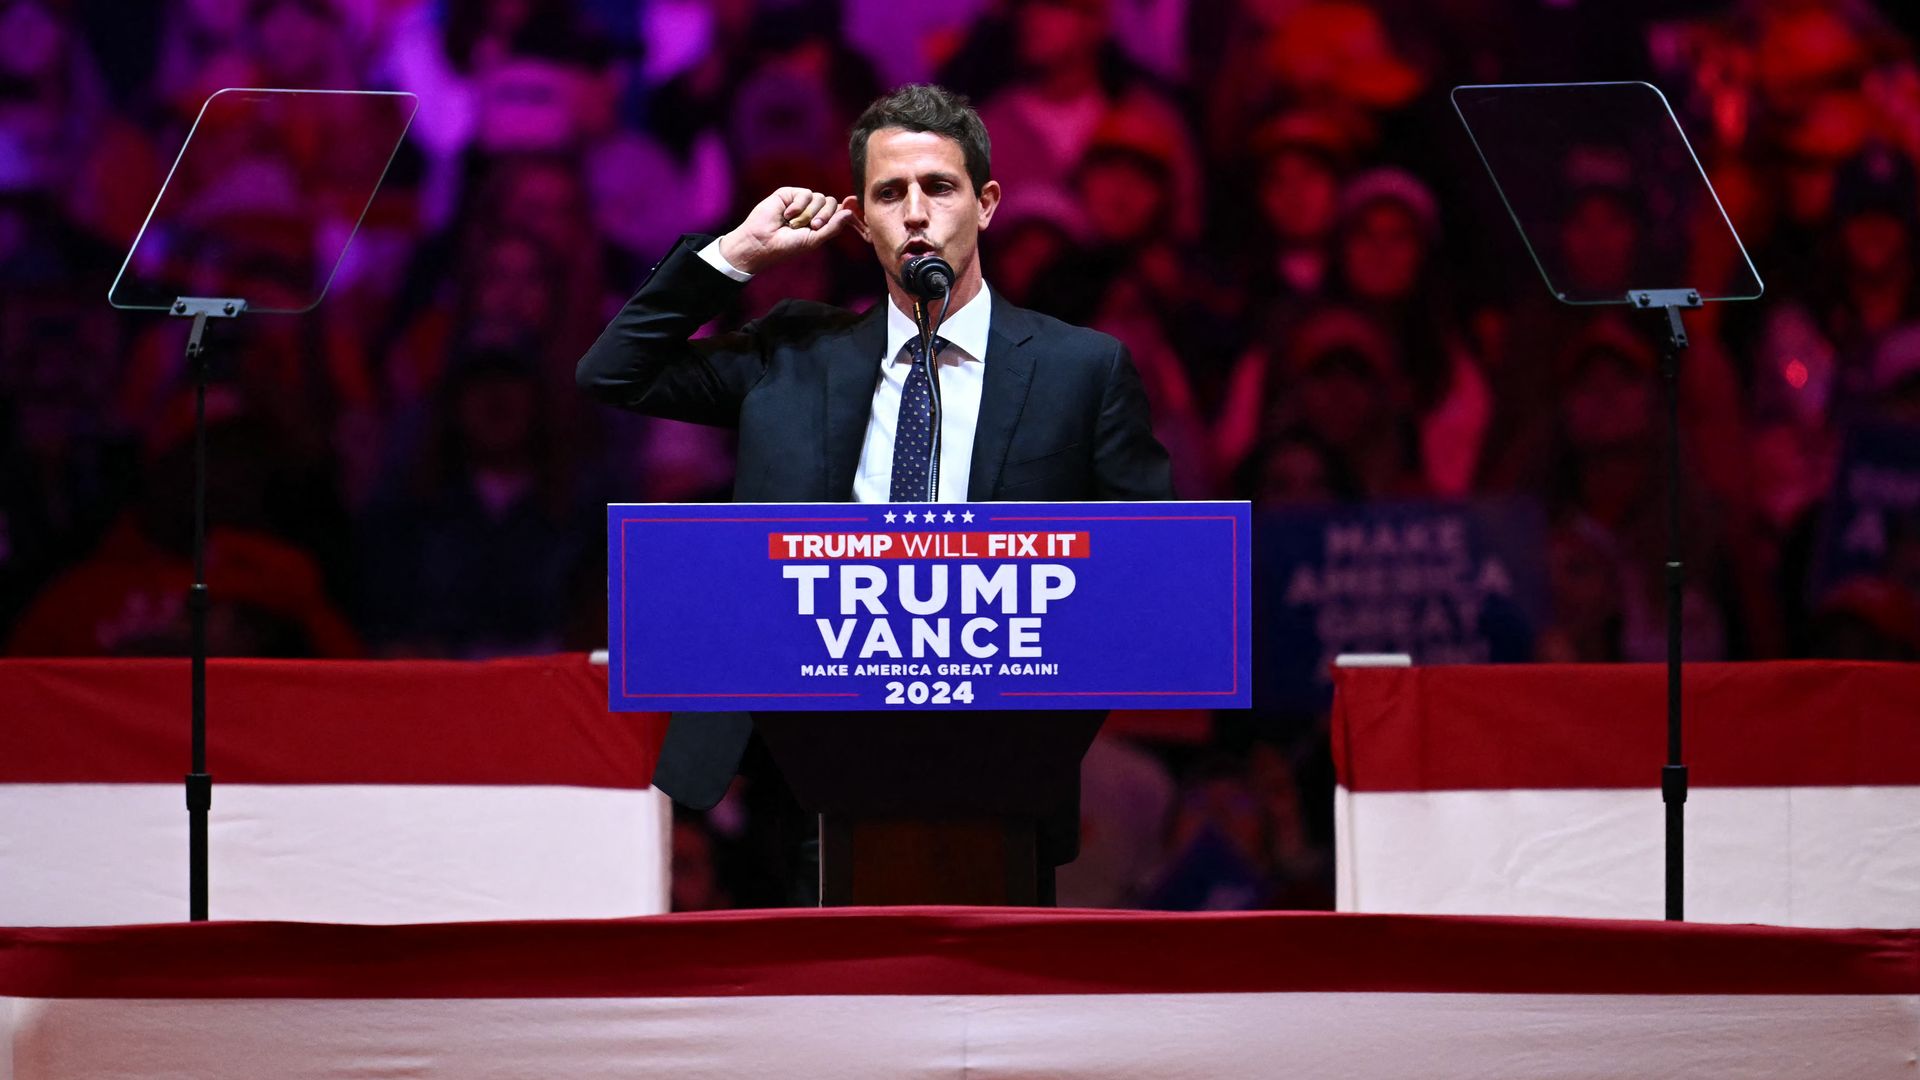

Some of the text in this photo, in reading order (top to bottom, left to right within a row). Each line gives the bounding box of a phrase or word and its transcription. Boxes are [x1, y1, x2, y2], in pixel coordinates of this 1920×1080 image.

[782, 533, 1077, 558] TRUMP WILL FIX IT
[782, 563, 1077, 616] TRUMP
[815, 617, 1043, 659] VANCE
[800, 663, 1059, 677] MAKE AMERICA GREAT AGAIN!
[884, 680, 975, 705] 2024
